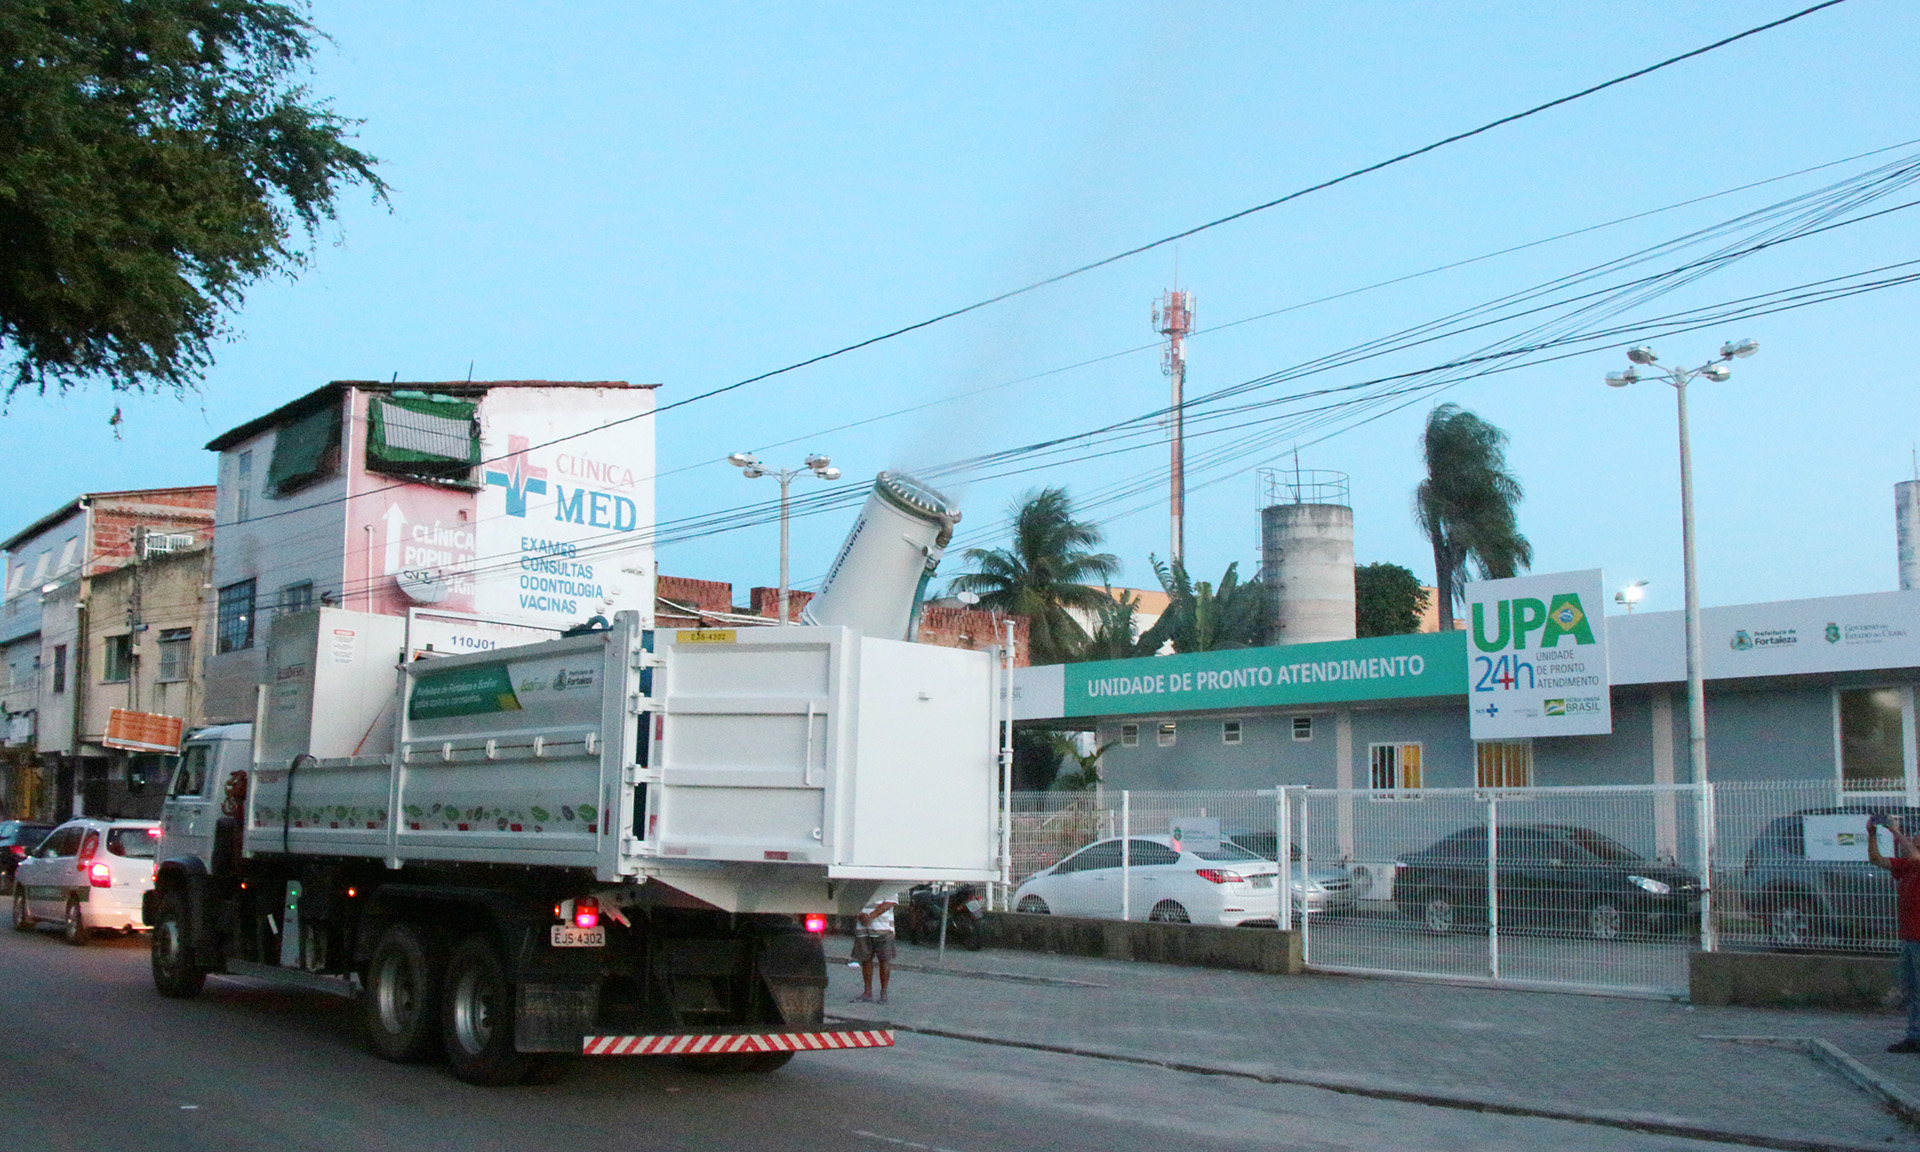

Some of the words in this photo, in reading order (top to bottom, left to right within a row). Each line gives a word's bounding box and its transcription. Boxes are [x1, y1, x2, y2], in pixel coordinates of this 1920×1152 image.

[555, 453, 636, 489] CLÍNICA
[555, 484, 636, 532] MED
[413, 520, 475, 552] CLÍNICA
[521, 536, 577, 559] EXAMES
[520, 555, 593, 580] CONSULTAS
[520, 575, 604, 599] ODONTOLOGIA
[519, 594, 577, 615] VACINAS
[1471, 592, 1596, 653] UPA
[451, 635, 496, 652] 110J01
[1754, 636, 1798, 645] Fortaleza
[1535, 650, 1575, 662] UNIDADE
[1087, 674, 1165, 697] UNIDADE
[1168, 671, 1192, 691] DE
[1196, 666, 1273, 690] PRONTO
[1276, 654, 1426, 685] ATENDIMENTO
[1475, 654, 1535, 692] 24h
[1536, 665, 1548, 675] DE
[1550, 663, 1585, 673] PRONTO
[1537, 676, 1599, 689] ATENDIMENTO
[1566, 701, 1600, 712] BRASIL
[554, 932, 603, 944] EJS-4302
